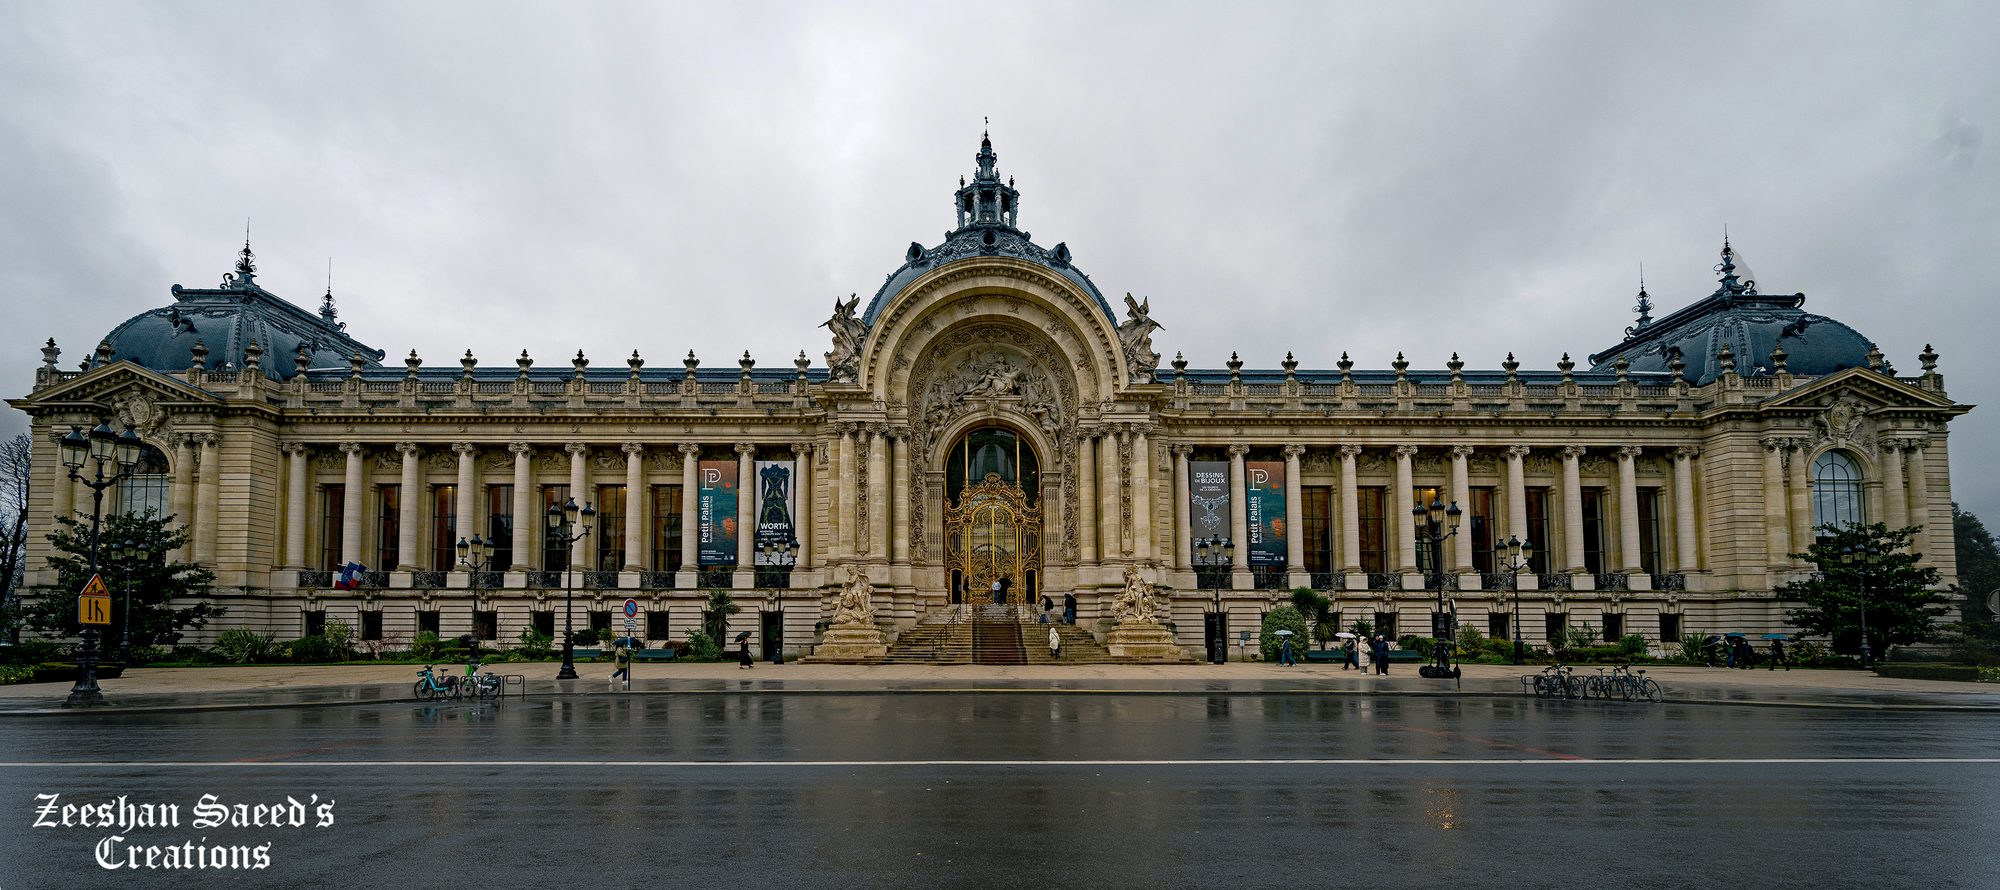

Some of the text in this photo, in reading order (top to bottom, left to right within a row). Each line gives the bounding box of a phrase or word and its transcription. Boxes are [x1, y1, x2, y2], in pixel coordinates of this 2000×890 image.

[701, 496, 710, 520] Palais
[1250, 496, 1258, 521] Palais
[701, 522, 709, 543] Petit
[1250, 523, 1258, 544] Petit
